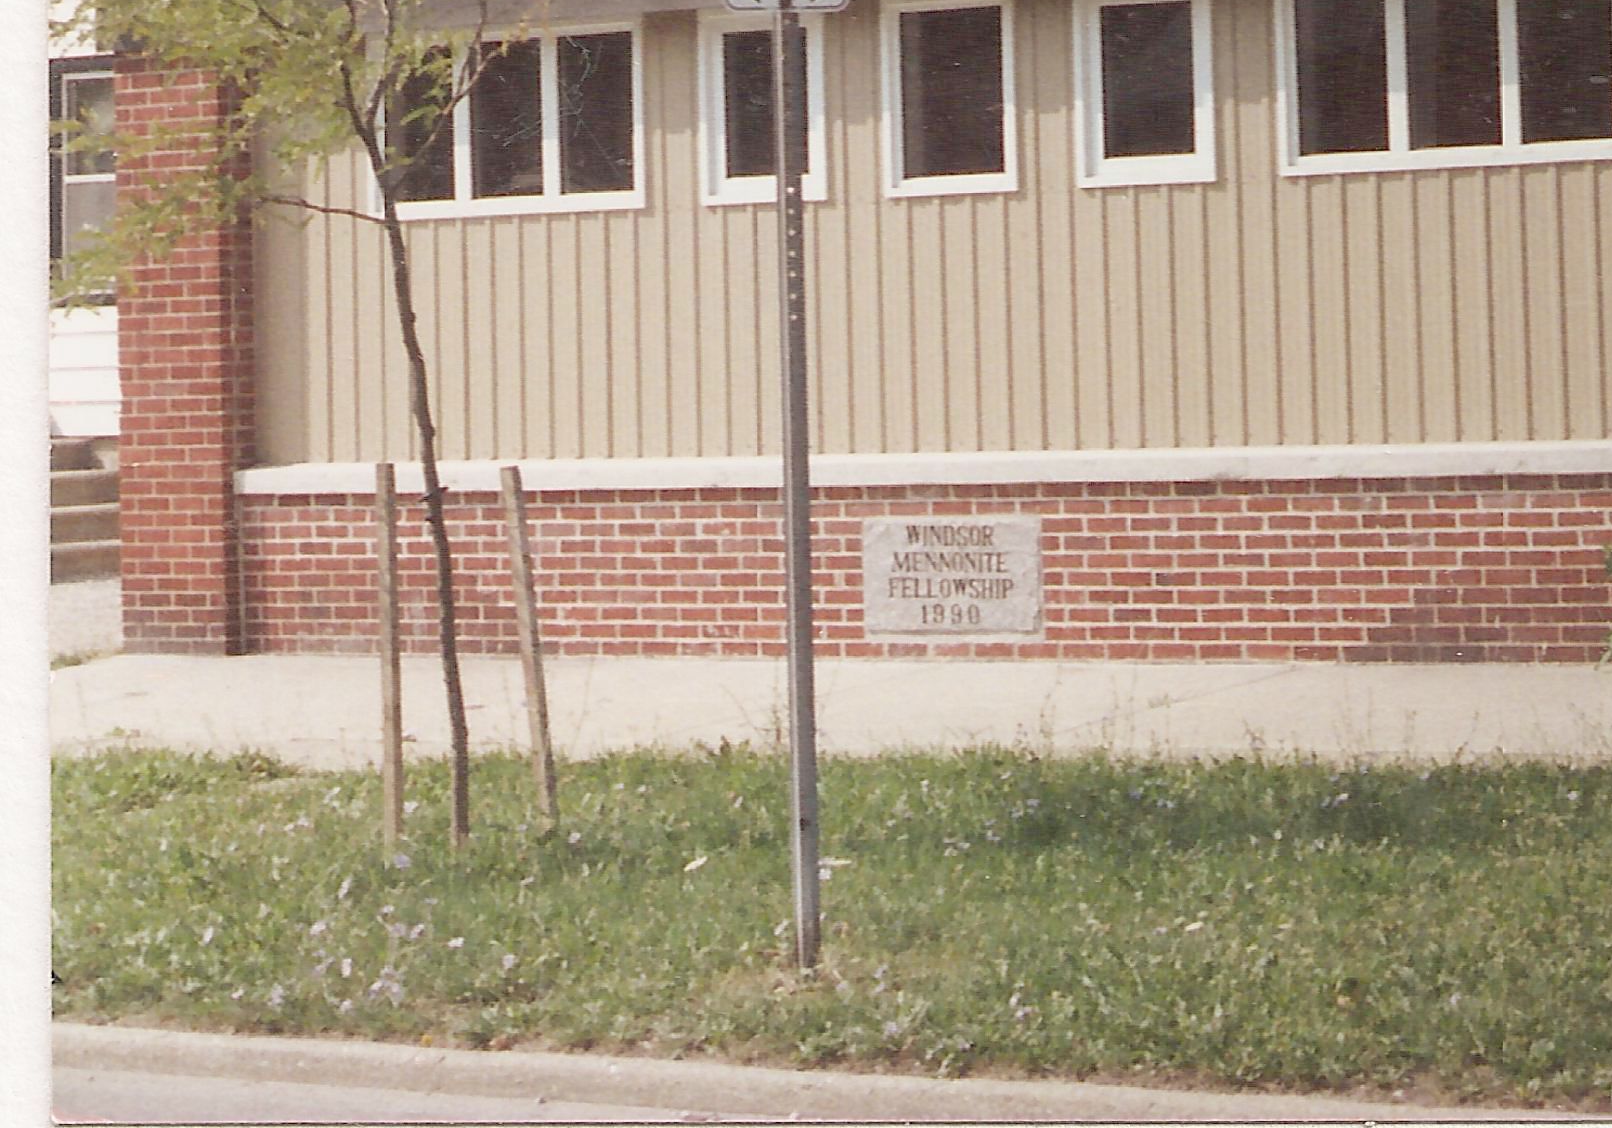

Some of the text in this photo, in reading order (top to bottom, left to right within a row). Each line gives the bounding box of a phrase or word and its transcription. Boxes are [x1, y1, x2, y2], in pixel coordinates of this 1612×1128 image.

[906, 524, 994, 547] WINDSOR
[891, 551, 1009, 573] MENNONITE
[888, 577, 1014, 599] FELLOWSHIP
[921, 603, 981, 625] 1990
